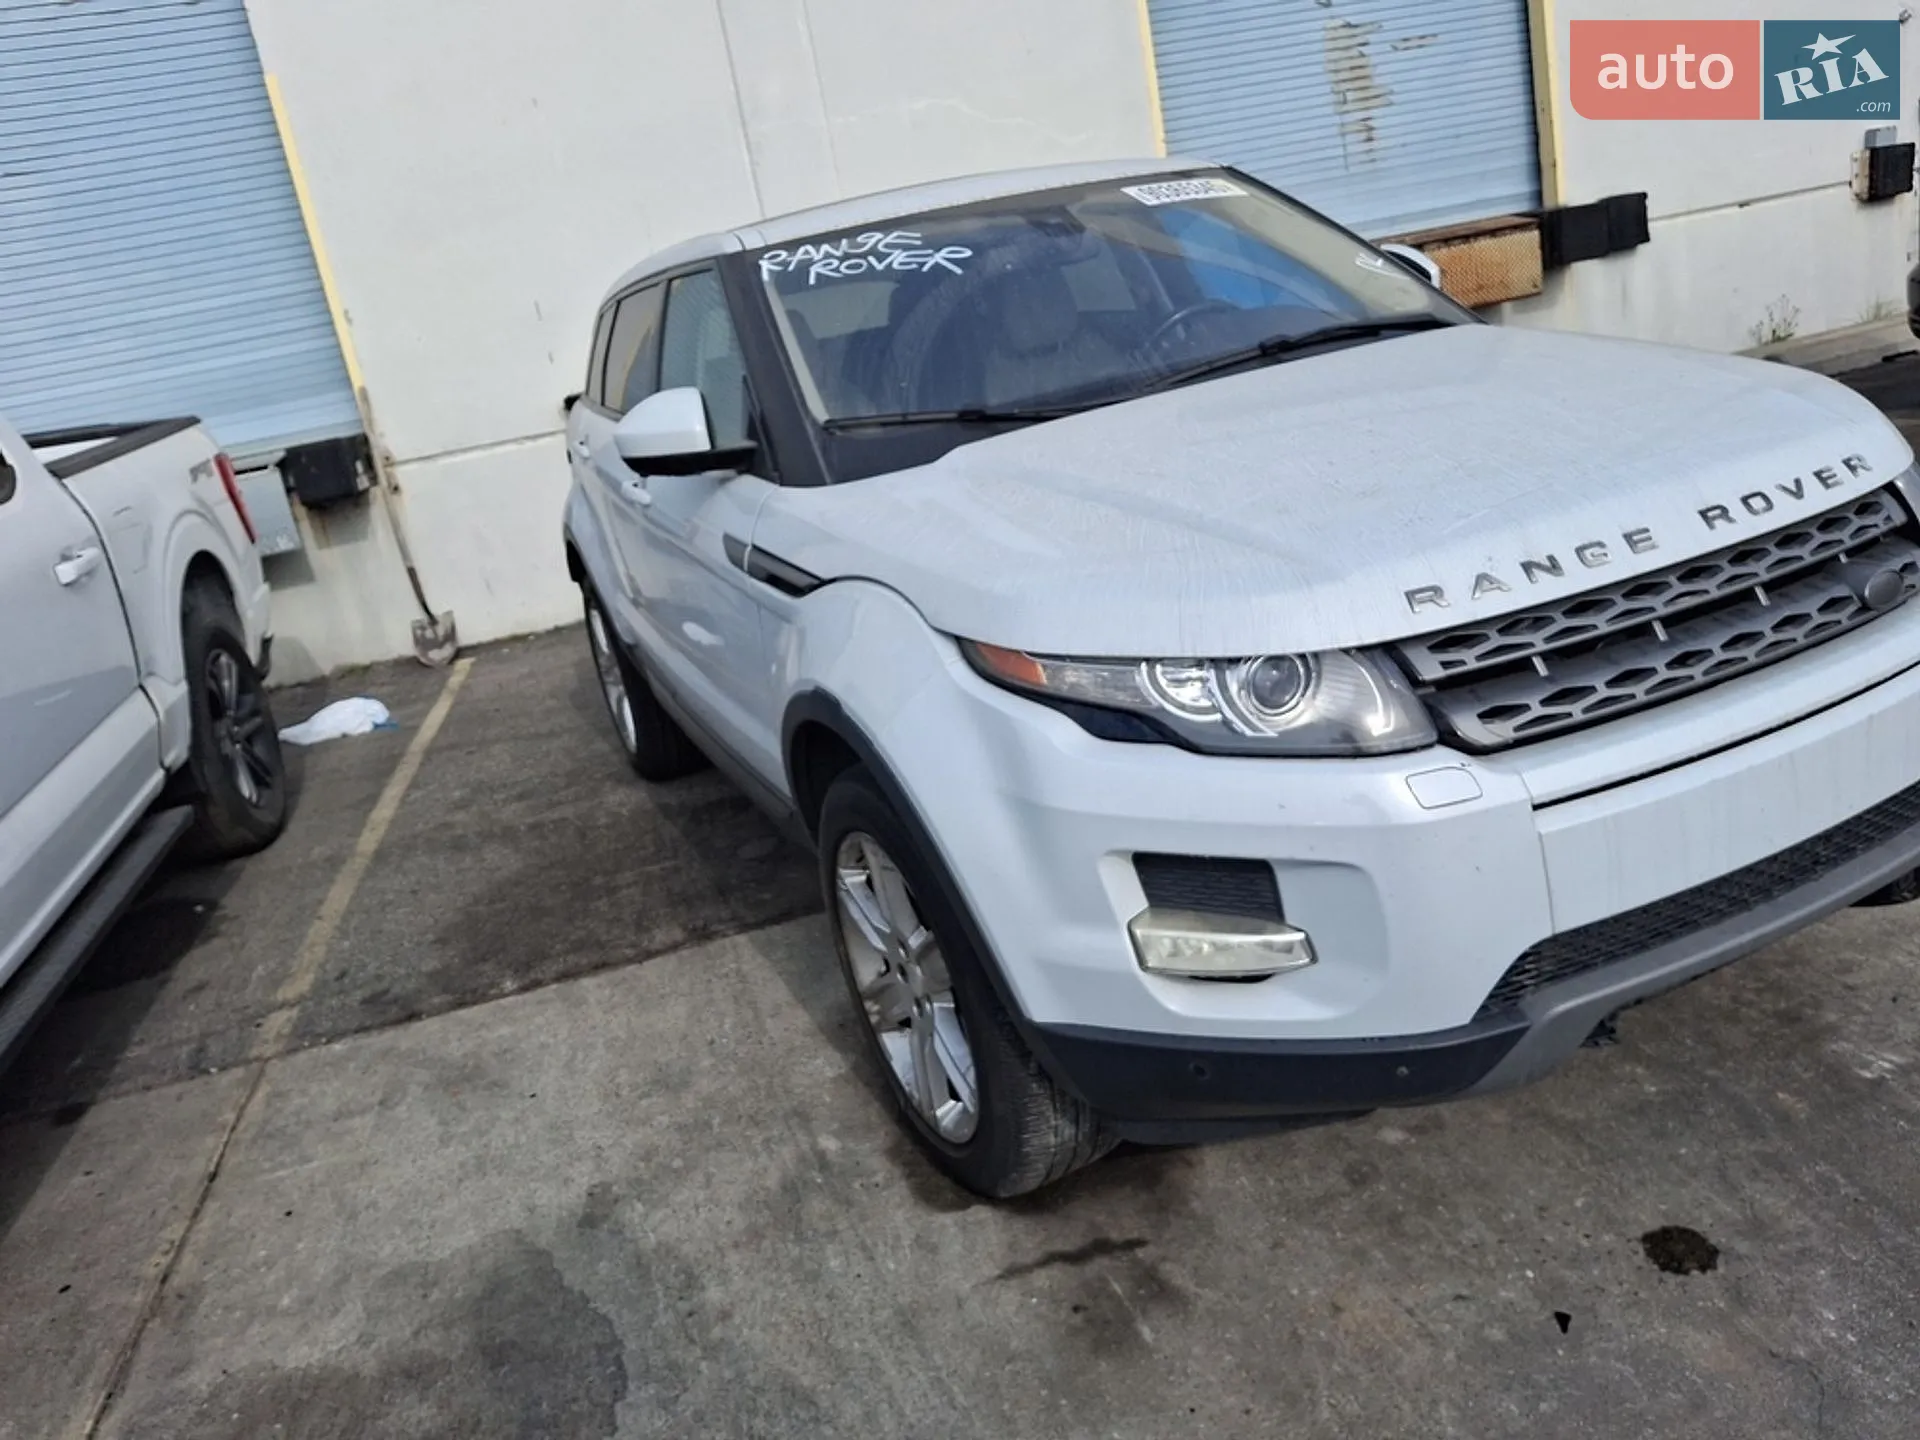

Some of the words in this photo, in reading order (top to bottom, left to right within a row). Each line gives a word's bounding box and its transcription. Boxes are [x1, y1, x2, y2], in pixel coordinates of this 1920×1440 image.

[758, 230, 922, 281] RANGE
[808, 246, 973, 285] ROVER
[1403, 526, 1660, 614] RANGE
[1696, 452, 1874, 531] ROVER
